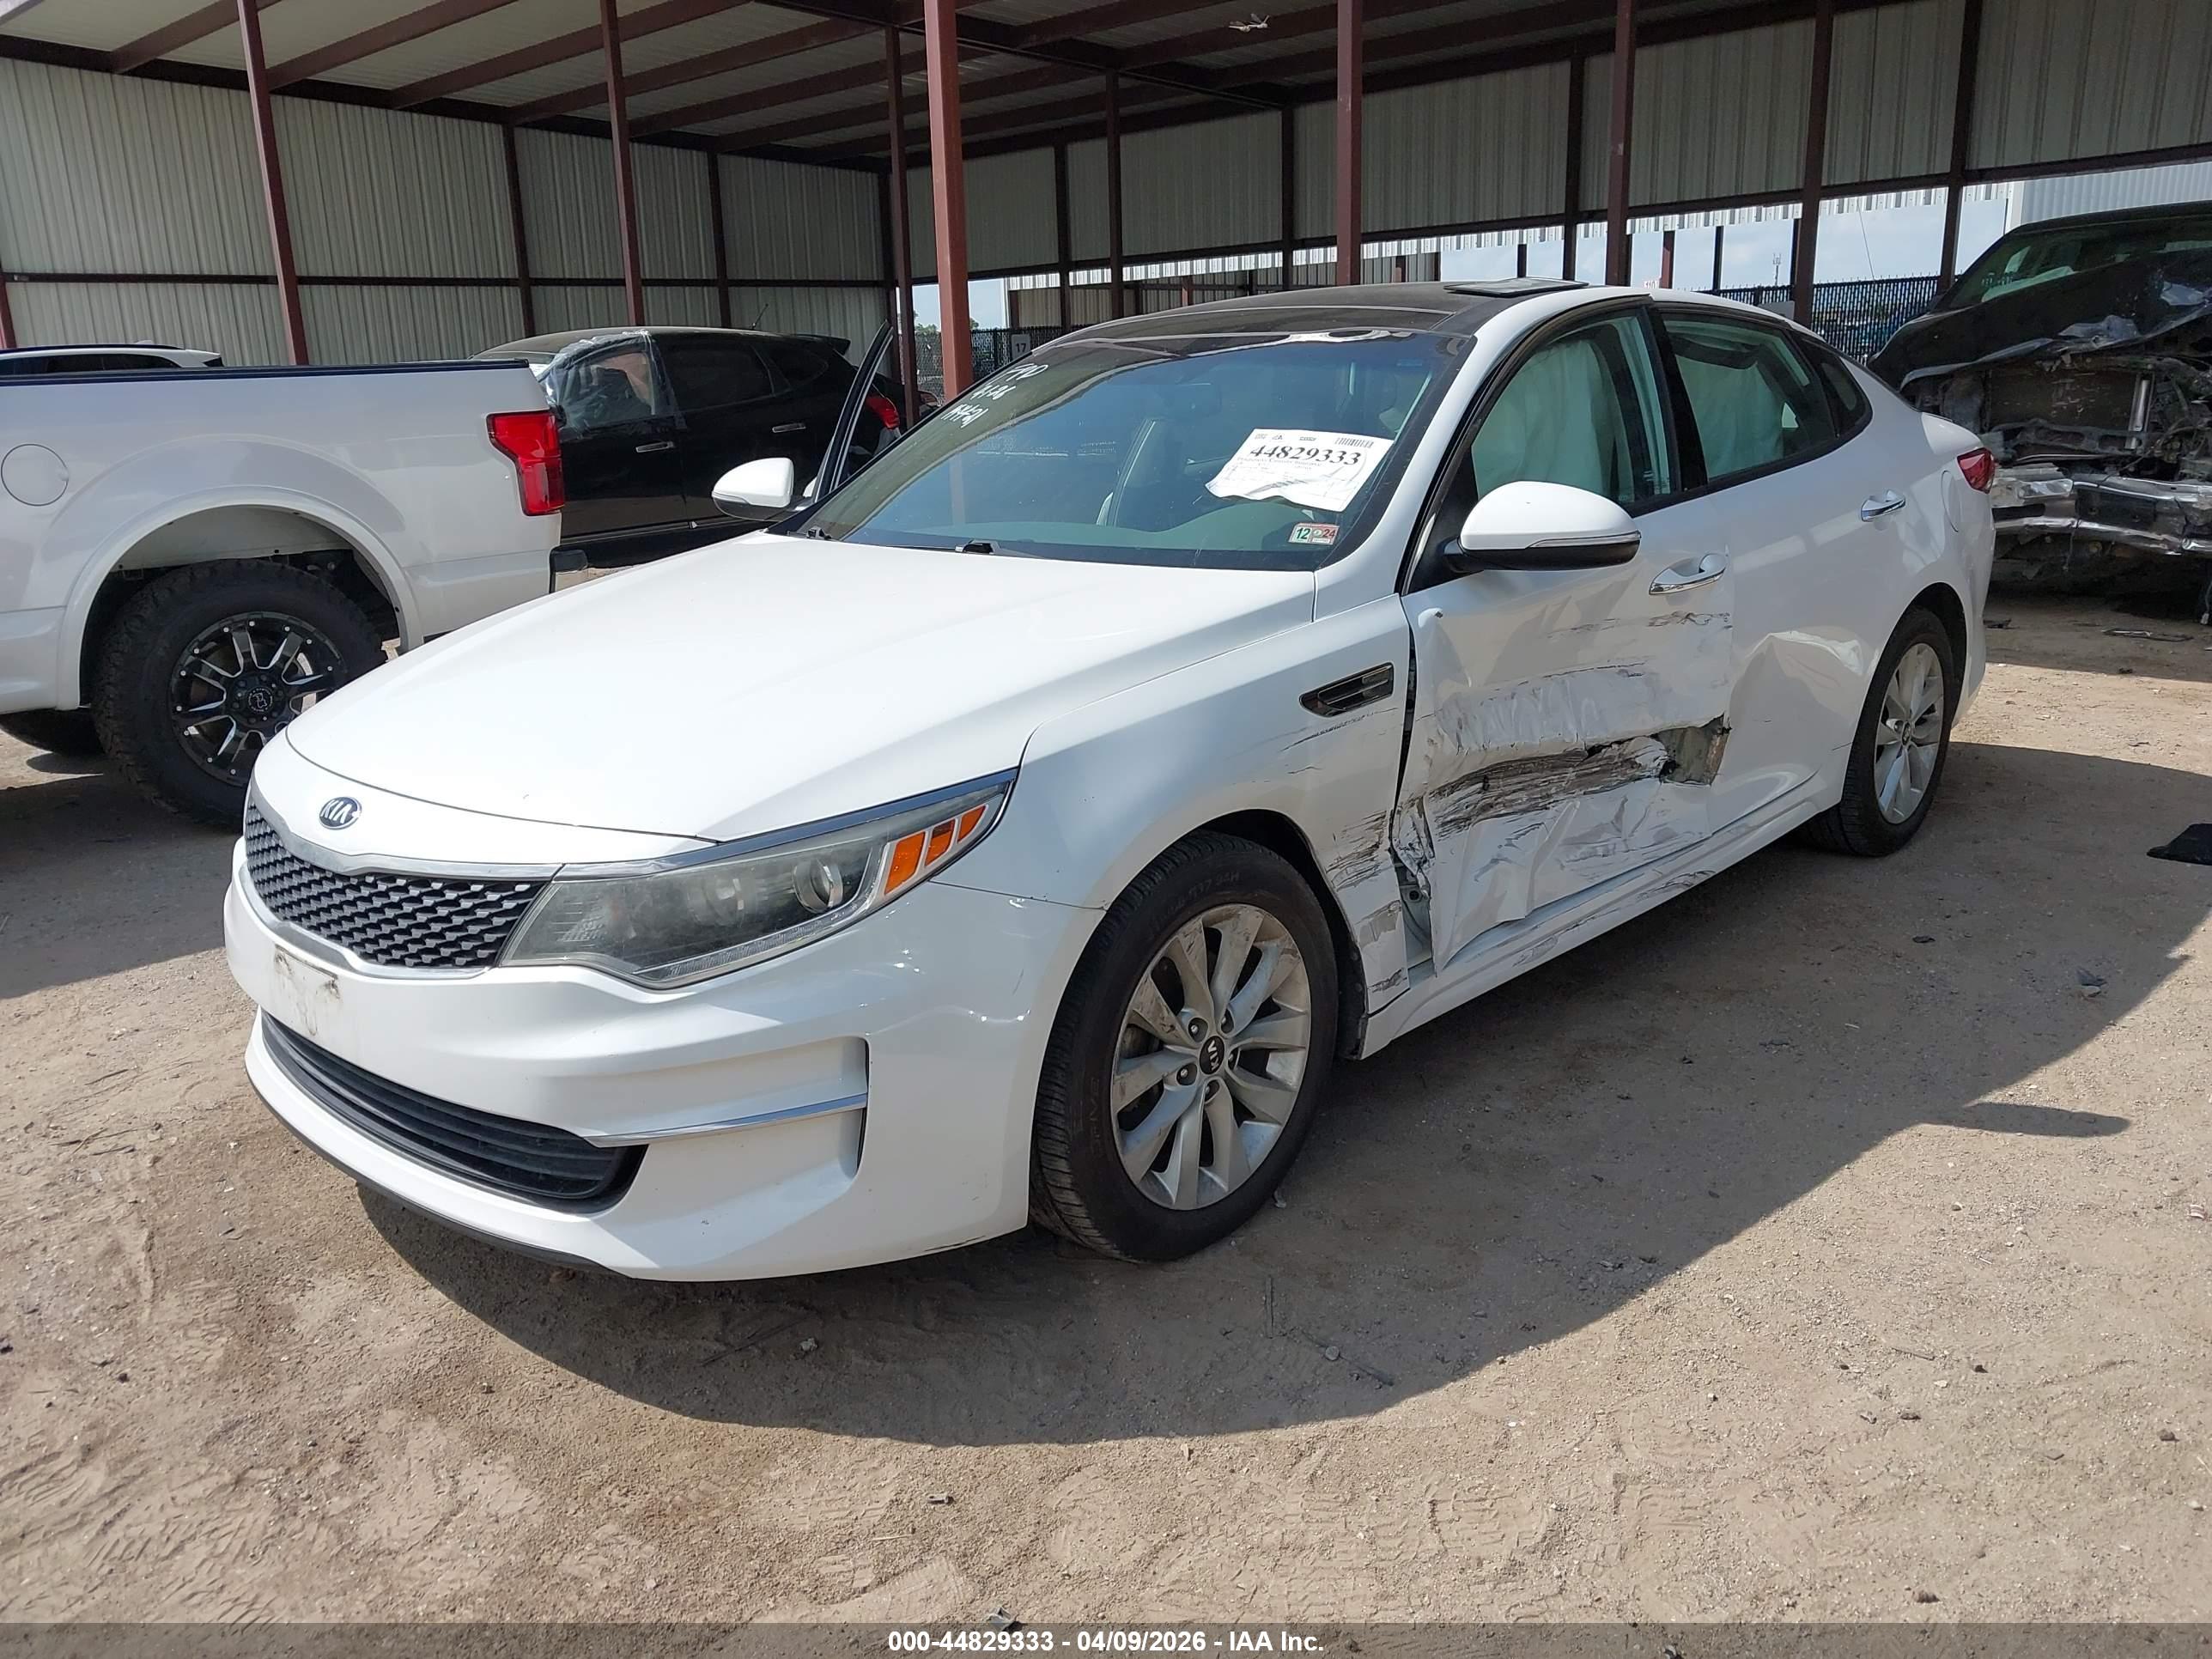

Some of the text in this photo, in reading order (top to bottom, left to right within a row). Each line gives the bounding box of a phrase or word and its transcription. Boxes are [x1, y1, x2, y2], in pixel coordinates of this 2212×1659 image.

[1015, 343, 1027, 353] 17
[1250, 444, 1362, 466] 44829333
[1297, 527, 1337, 540] 12 24
[319, 798, 353, 824] KIA
[1207, 1039, 1219, 1072] KIA
